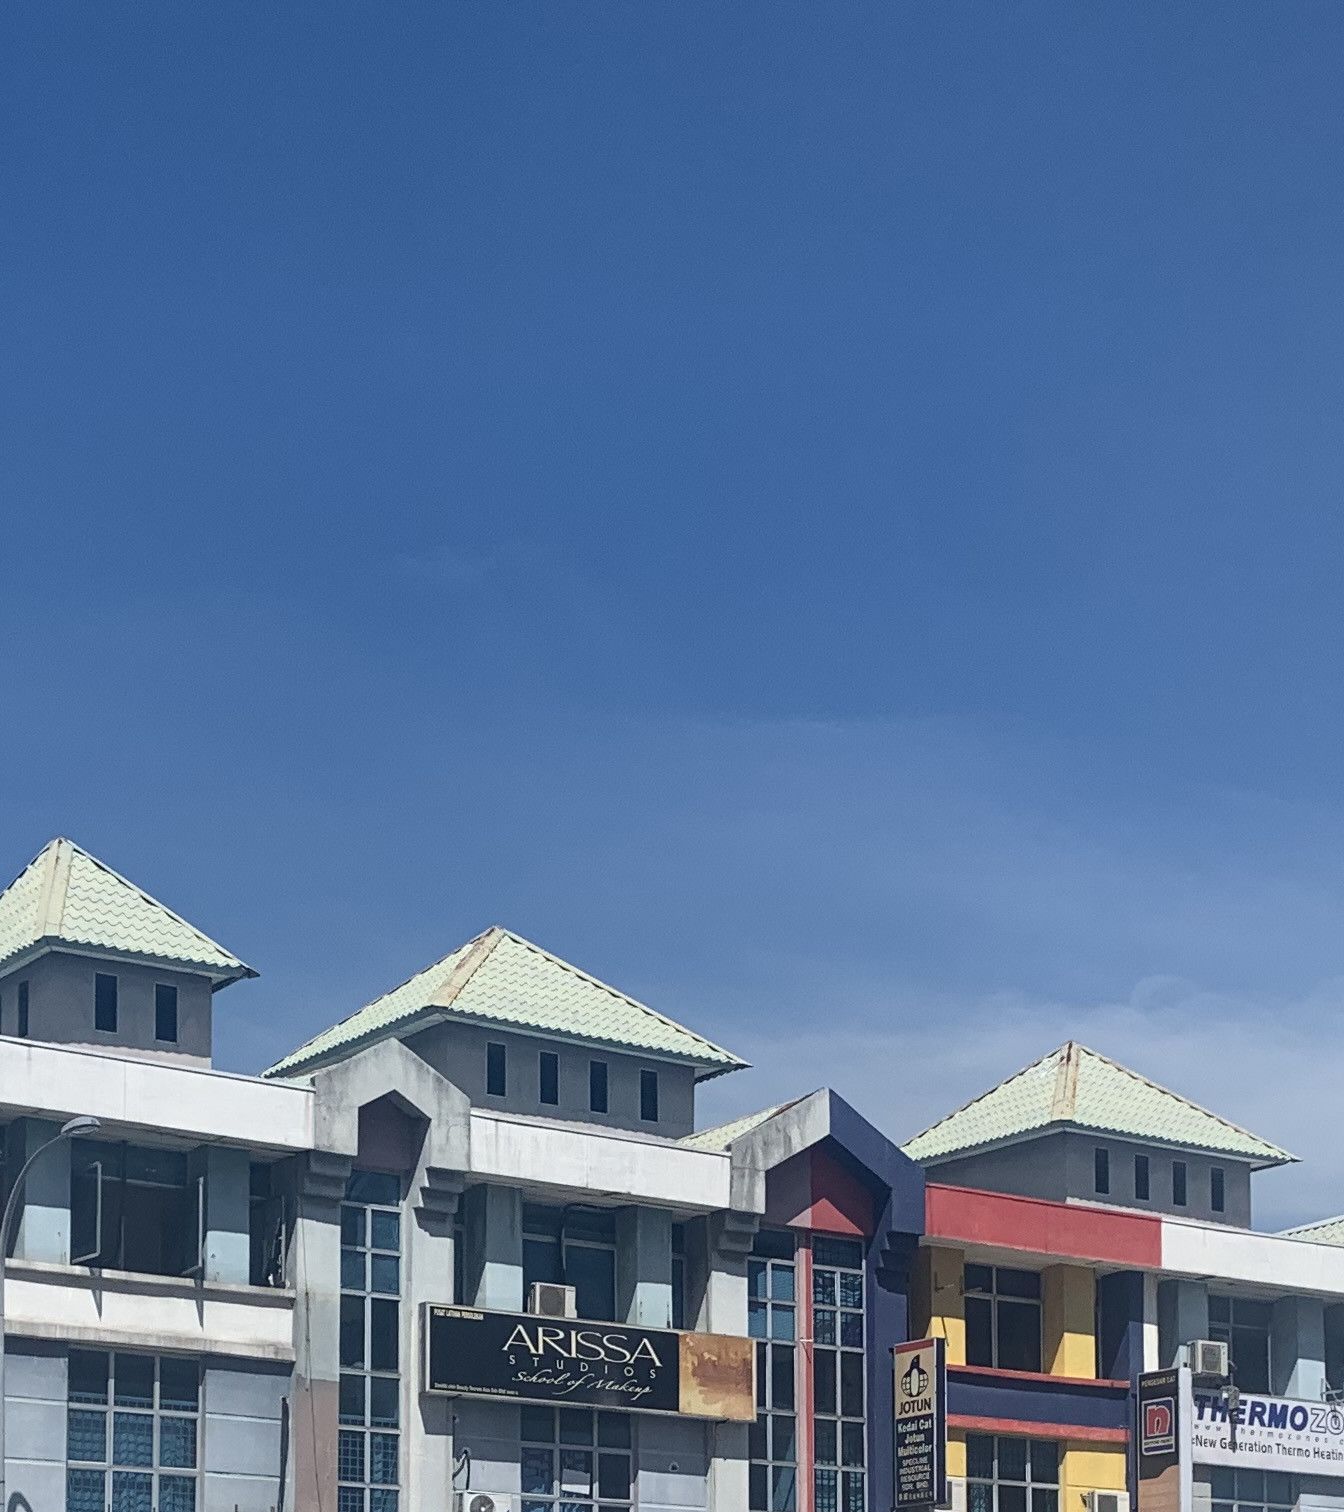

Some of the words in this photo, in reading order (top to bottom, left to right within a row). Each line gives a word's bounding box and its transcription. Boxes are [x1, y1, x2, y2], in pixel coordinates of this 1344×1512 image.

[501, 1324, 663, 1367] ARISSA
[509, 1354, 656, 1379] STUDIOS
[512, 1369, 571, 1385] School
[587, 1379, 653, 1401] Makeup
[898, 1397, 932, 1415] JOTUN
[898, 1420, 918, 1433] Kedai
[918, 1418, 932, 1430] Cat
[1275, 1442, 1311, 1459] Thermo
